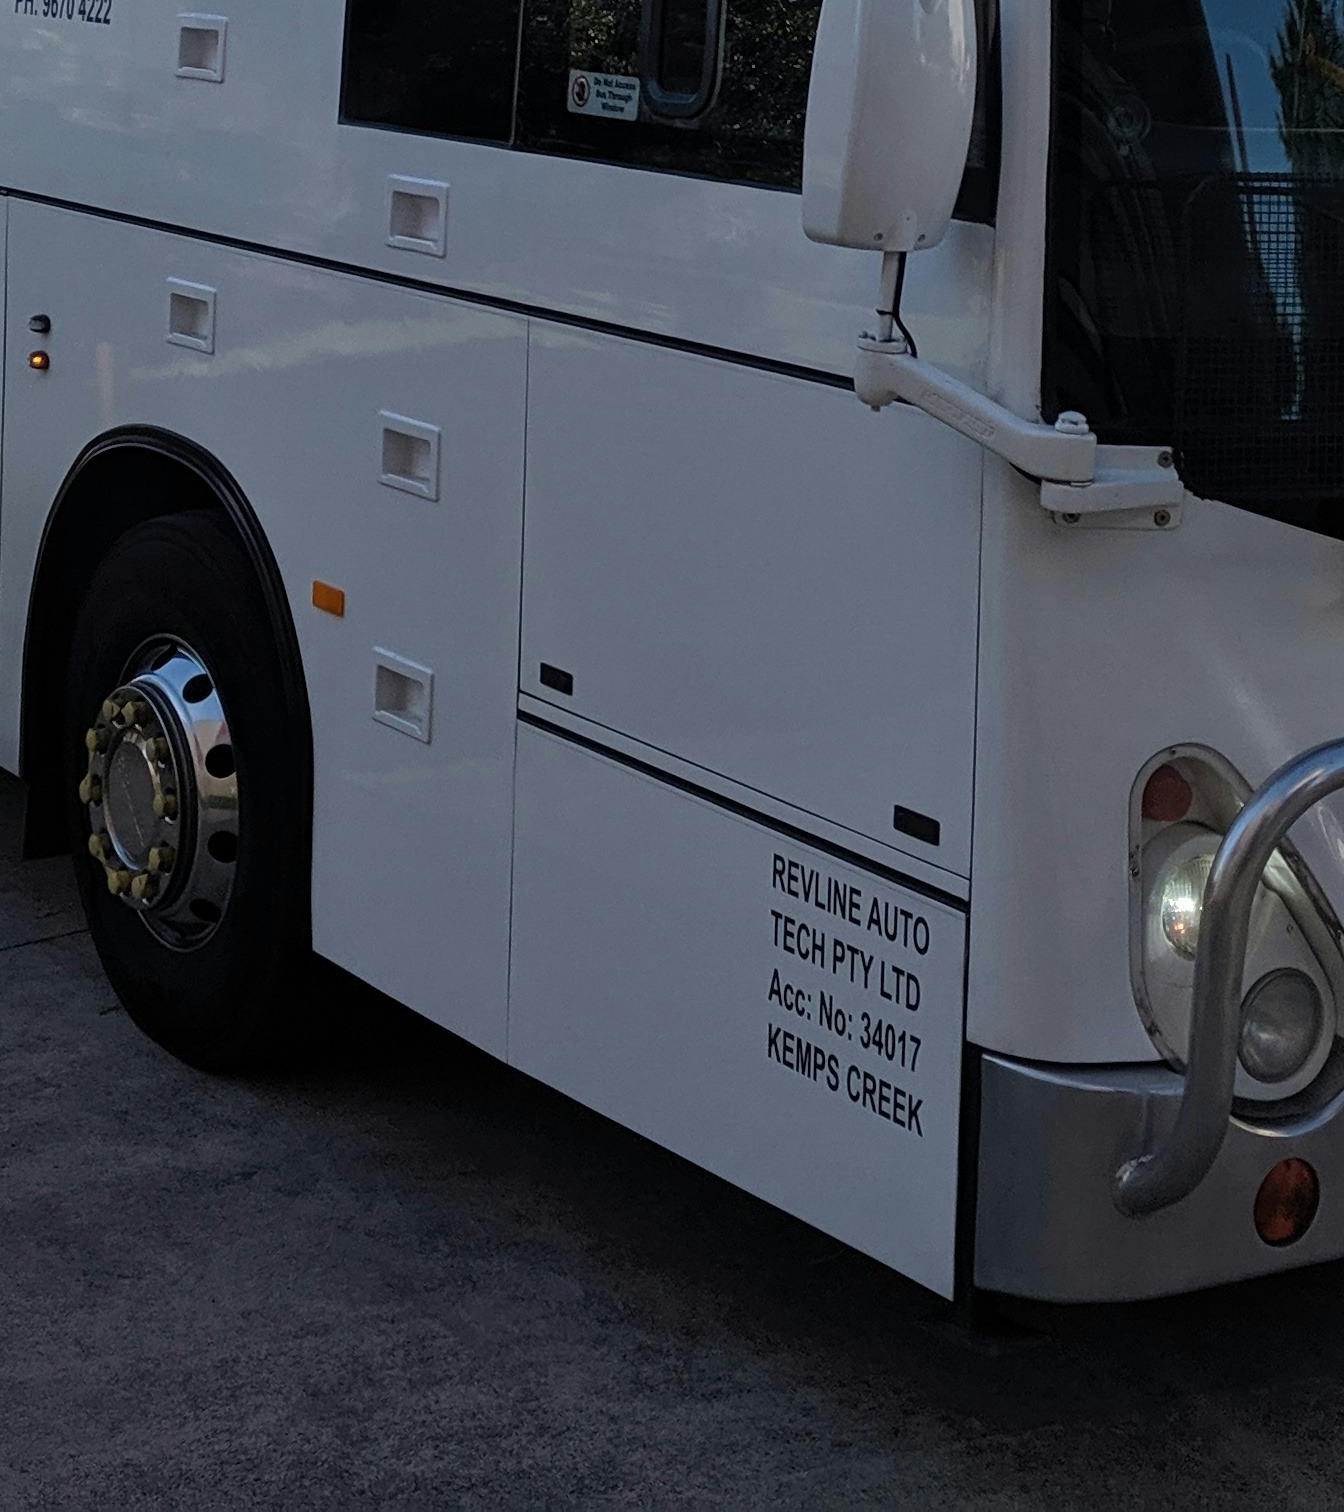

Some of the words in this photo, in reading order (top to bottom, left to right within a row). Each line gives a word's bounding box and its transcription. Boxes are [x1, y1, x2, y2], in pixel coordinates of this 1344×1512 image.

[772, 853, 862, 927] REVLINE
[866, 897, 930, 956] AUTO
[771, 909, 825, 969] TECH
[832, 938, 874, 989] PTY
[880, 961, 921, 1012] LTD
[768, 968, 812, 1020] Acc:
[819, 990, 853, 1041] No:
[860, 1012, 921, 1072] 34017
[767, 1023, 840, 1092] KEMPS
[846, 1065, 923, 1138] CREEK
